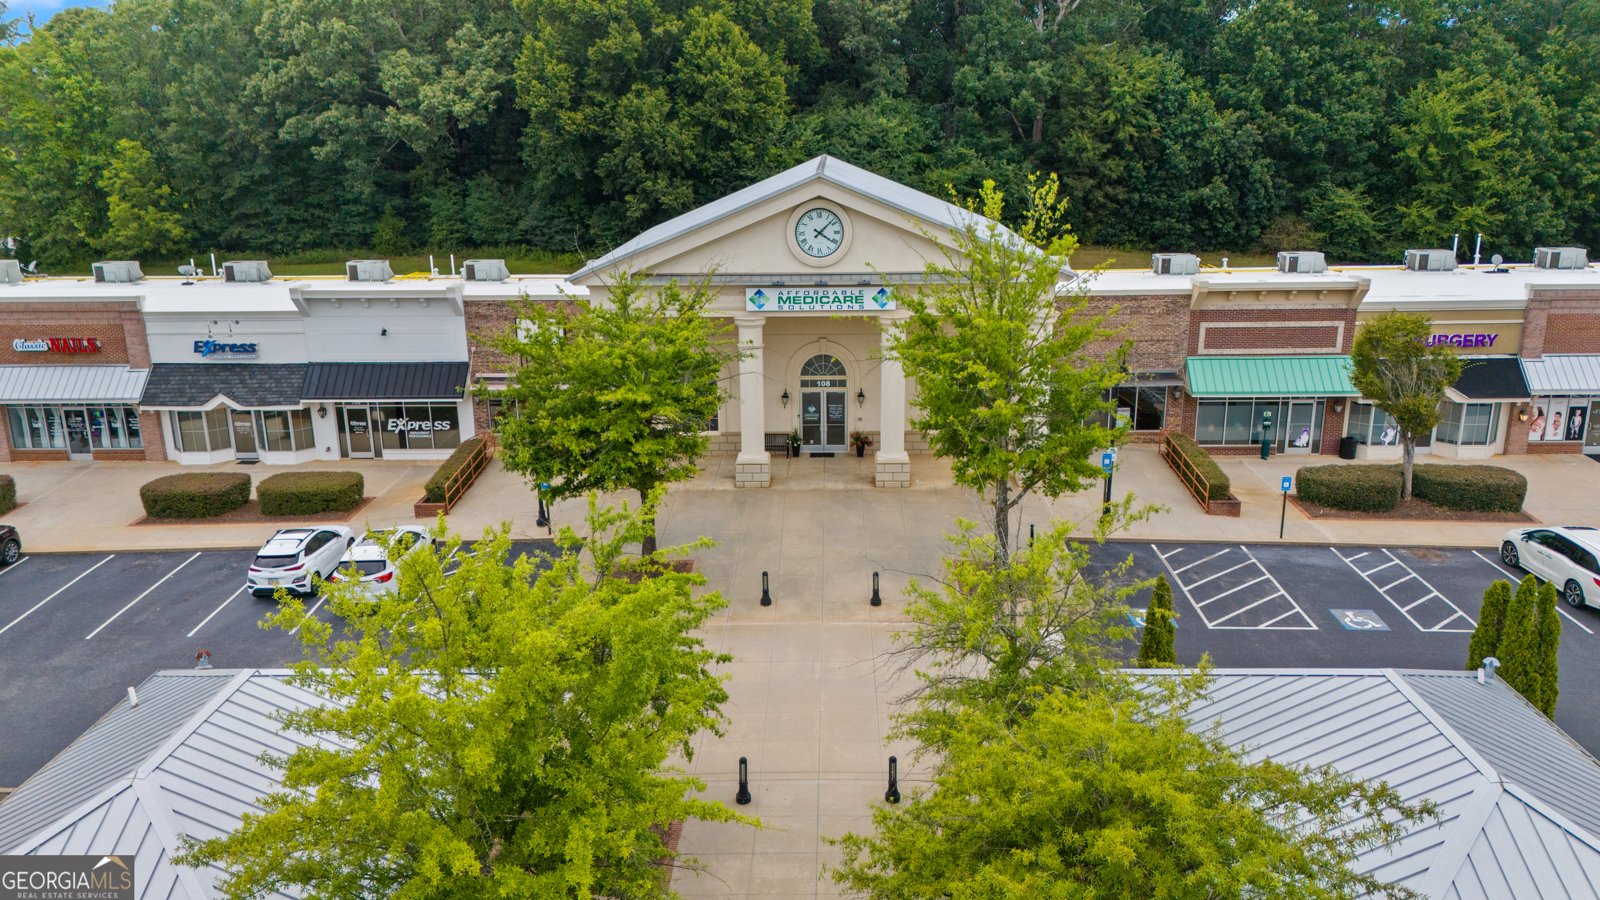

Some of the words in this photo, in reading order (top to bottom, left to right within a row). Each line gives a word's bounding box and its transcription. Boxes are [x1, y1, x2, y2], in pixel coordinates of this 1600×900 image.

[778, 296, 865, 305] MEDICARE
[14, 339, 47, 351] Classic
[48, 337, 98, 353] NAILS
